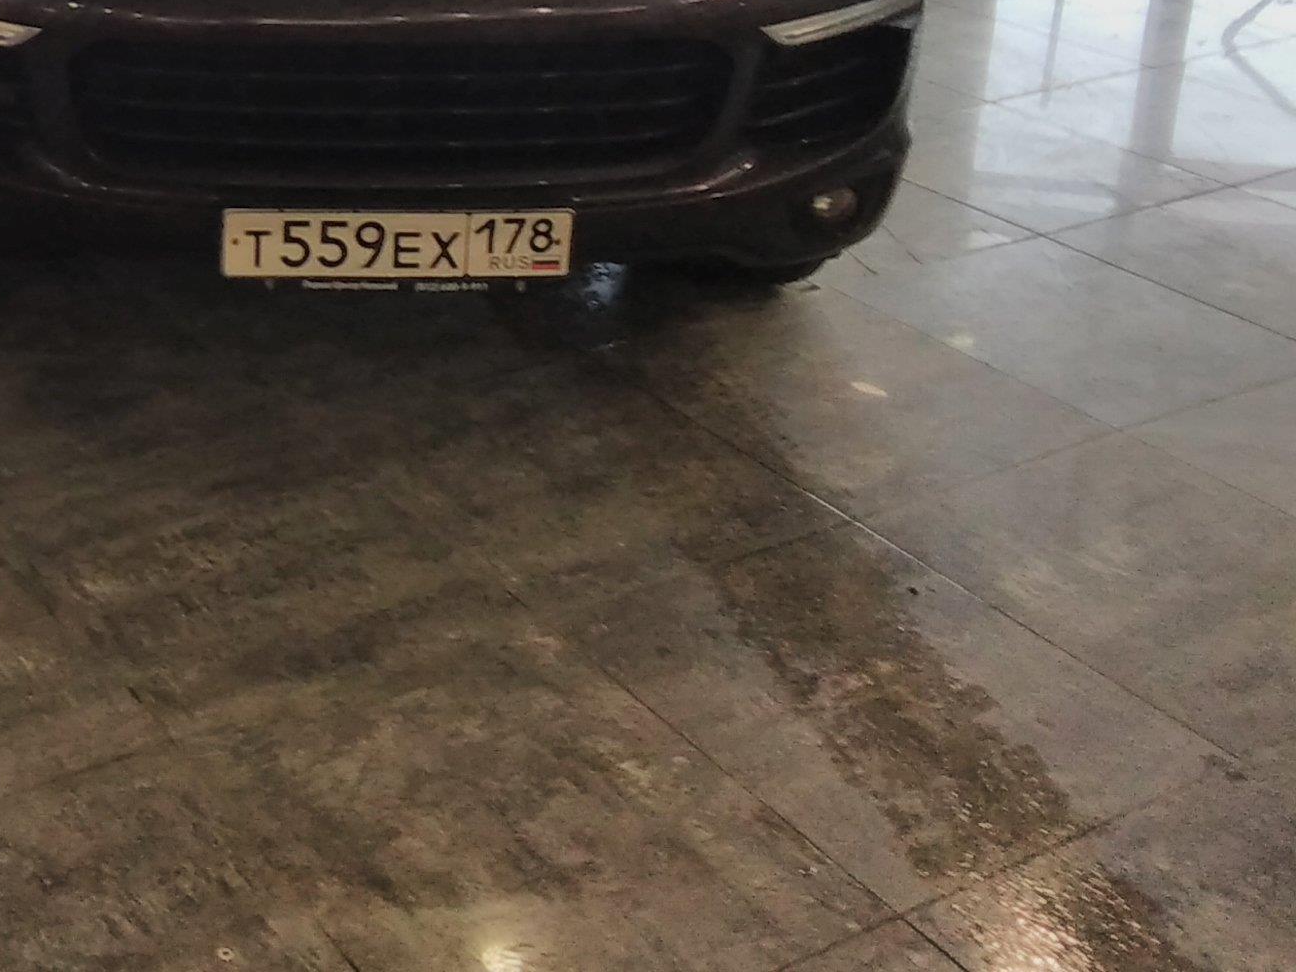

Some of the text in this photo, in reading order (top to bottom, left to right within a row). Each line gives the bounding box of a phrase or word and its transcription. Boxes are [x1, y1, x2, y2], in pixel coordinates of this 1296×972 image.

[245, 218, 555, 269] T559EX 178
[488, 256, 532, 270] RUS
